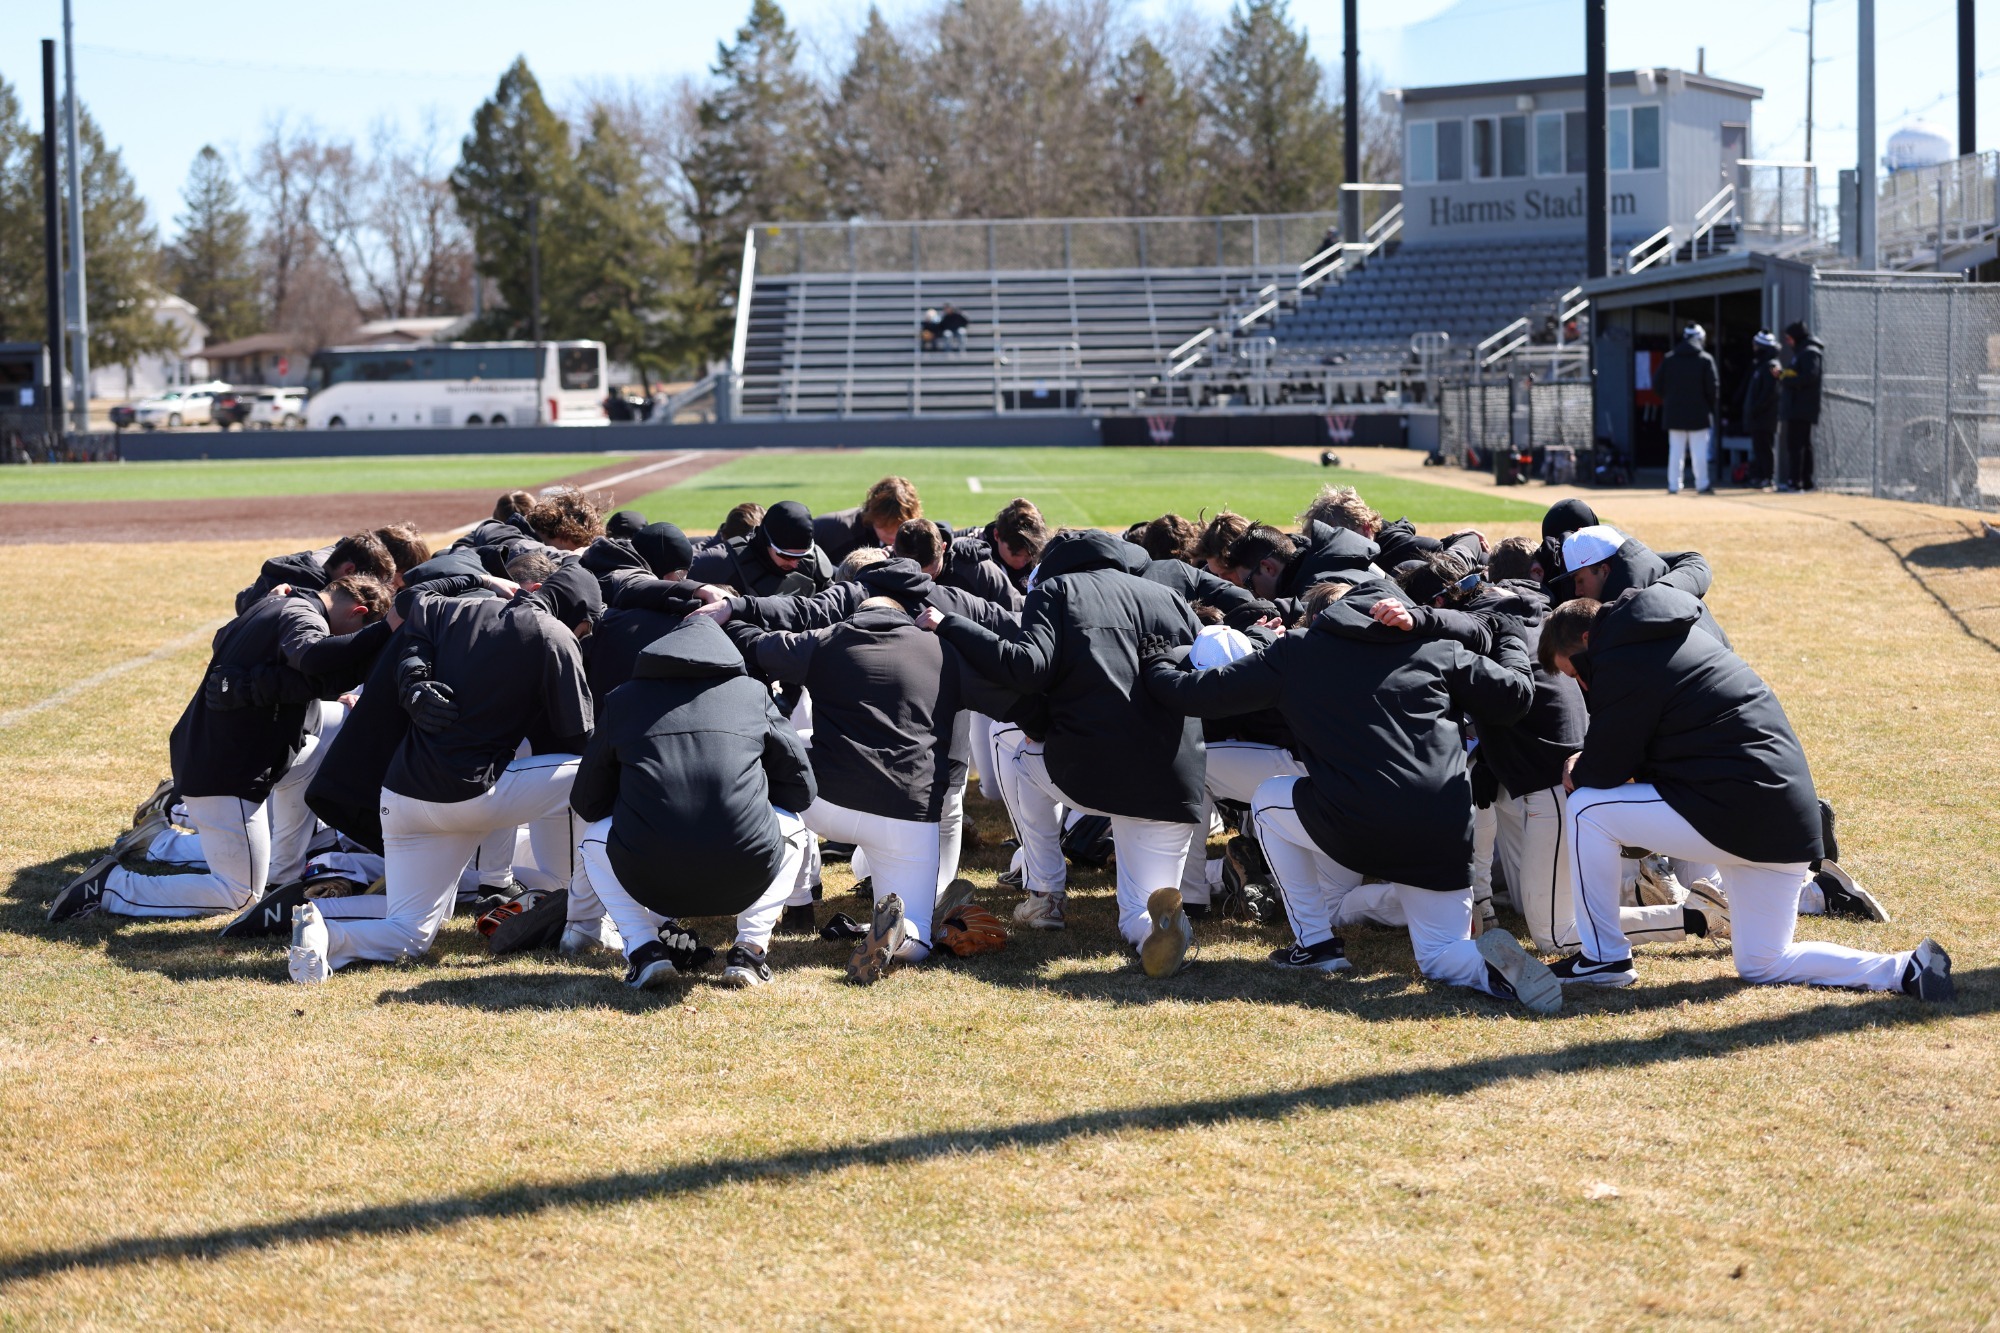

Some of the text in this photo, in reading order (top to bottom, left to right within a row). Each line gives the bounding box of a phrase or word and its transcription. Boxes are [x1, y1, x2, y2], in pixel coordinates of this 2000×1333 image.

[1430, 186, 1637, 227] Harms Stadm
[84, 879, 99, 899] N
[264, 902, 282, 927] N
